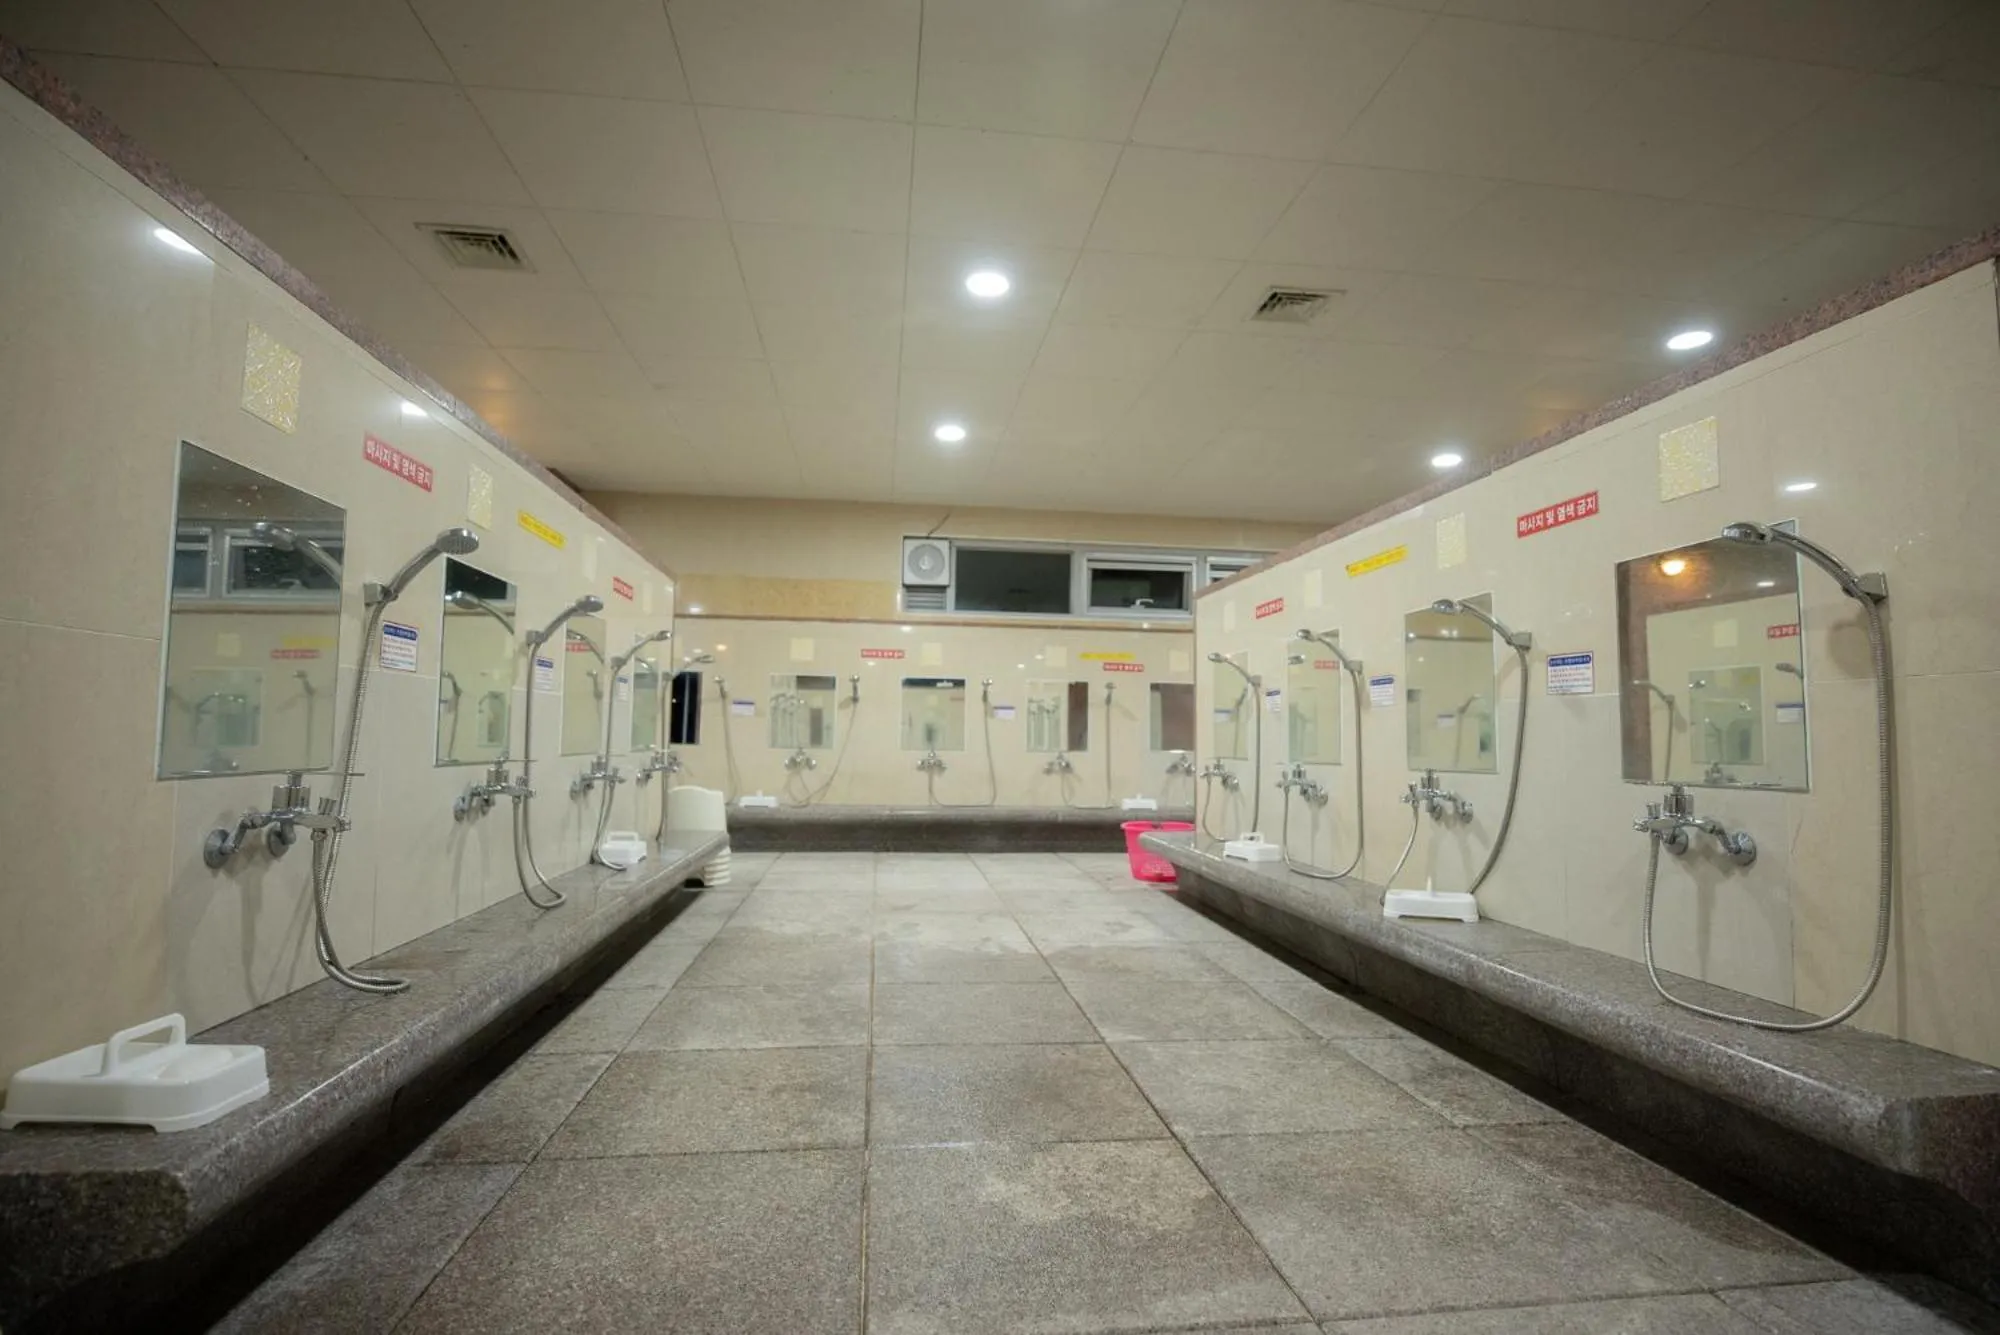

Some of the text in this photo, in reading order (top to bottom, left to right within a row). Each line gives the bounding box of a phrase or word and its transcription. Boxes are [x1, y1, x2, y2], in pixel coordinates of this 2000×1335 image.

[367, 440, 390, 467] 마사지
[1519, 496, 1596, 533] 마사지 및 염색 금지
